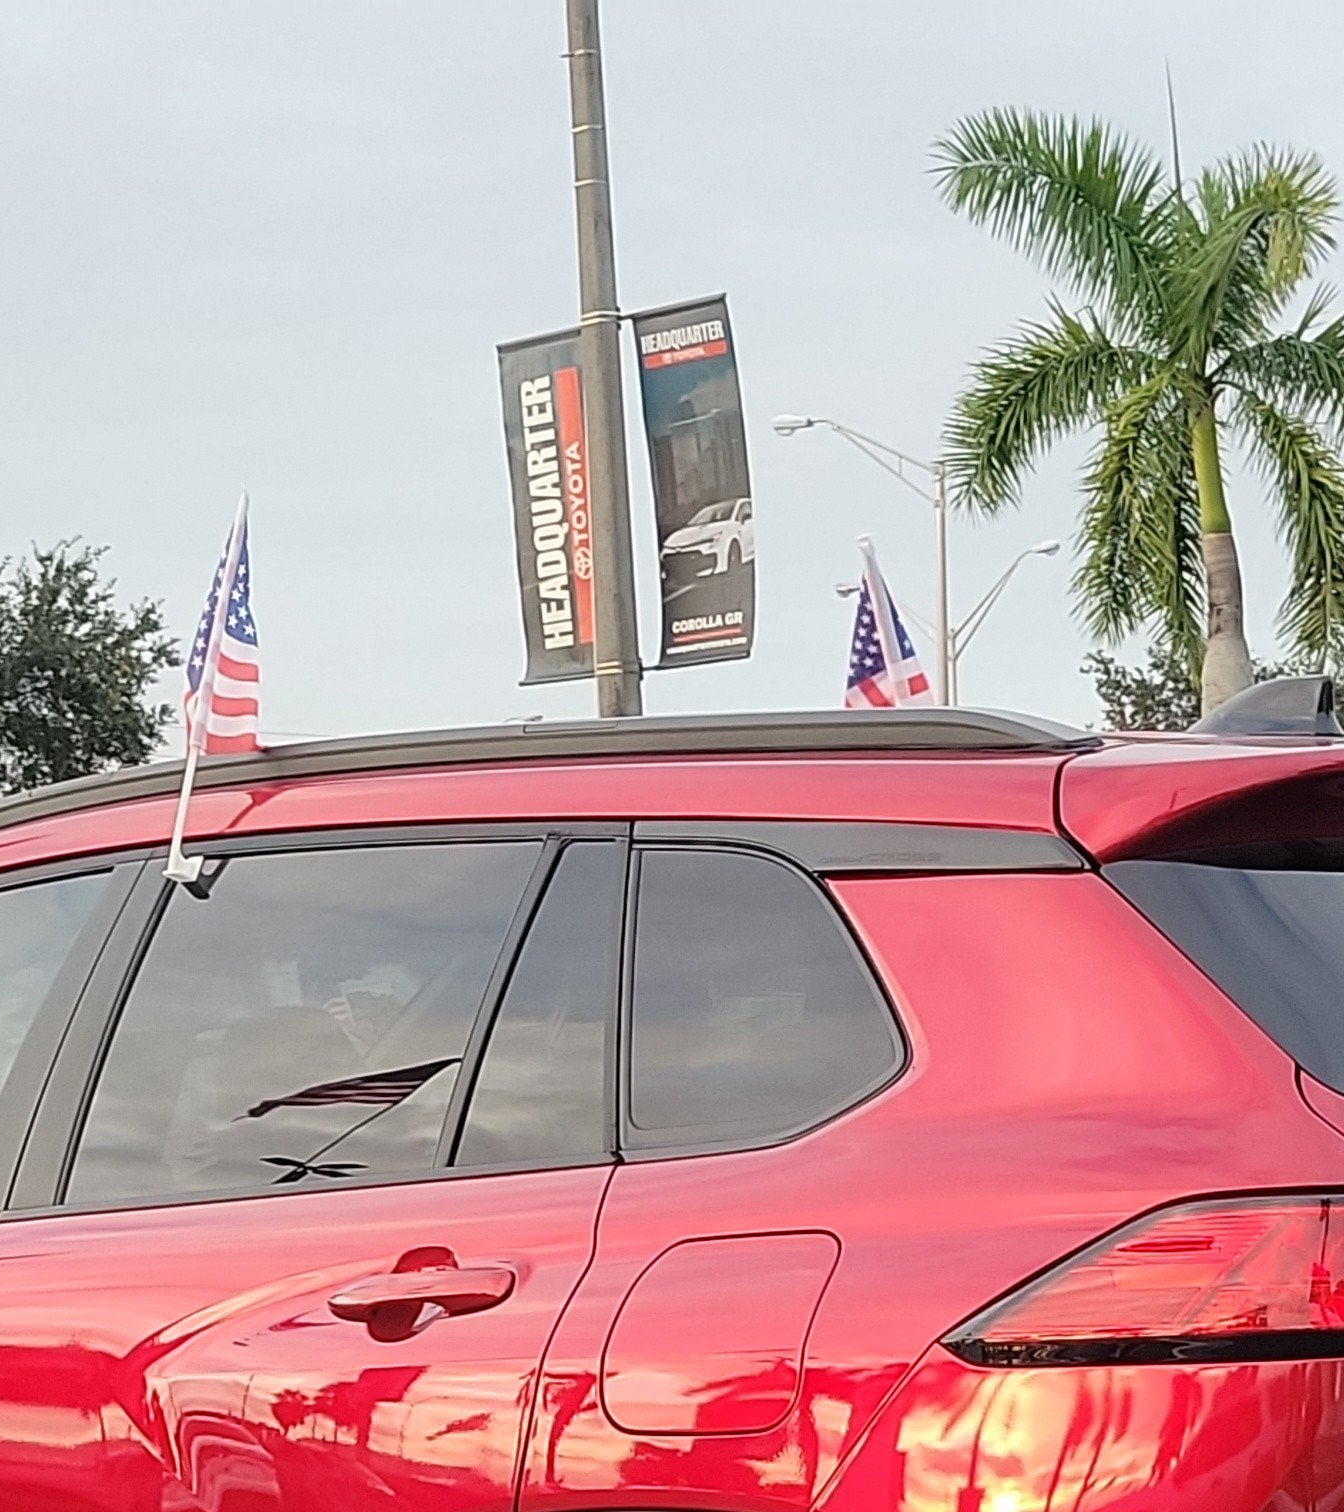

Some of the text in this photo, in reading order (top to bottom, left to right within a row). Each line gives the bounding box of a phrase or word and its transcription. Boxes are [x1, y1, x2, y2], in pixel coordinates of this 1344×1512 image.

[640, 319, 725, 355] HEADQUARTER
[520, 374, 575, 650] HEADQUARTER
[566, 441, 590, 547] TOYOTA
[671, 611, 743, 634] COROLLA GR
